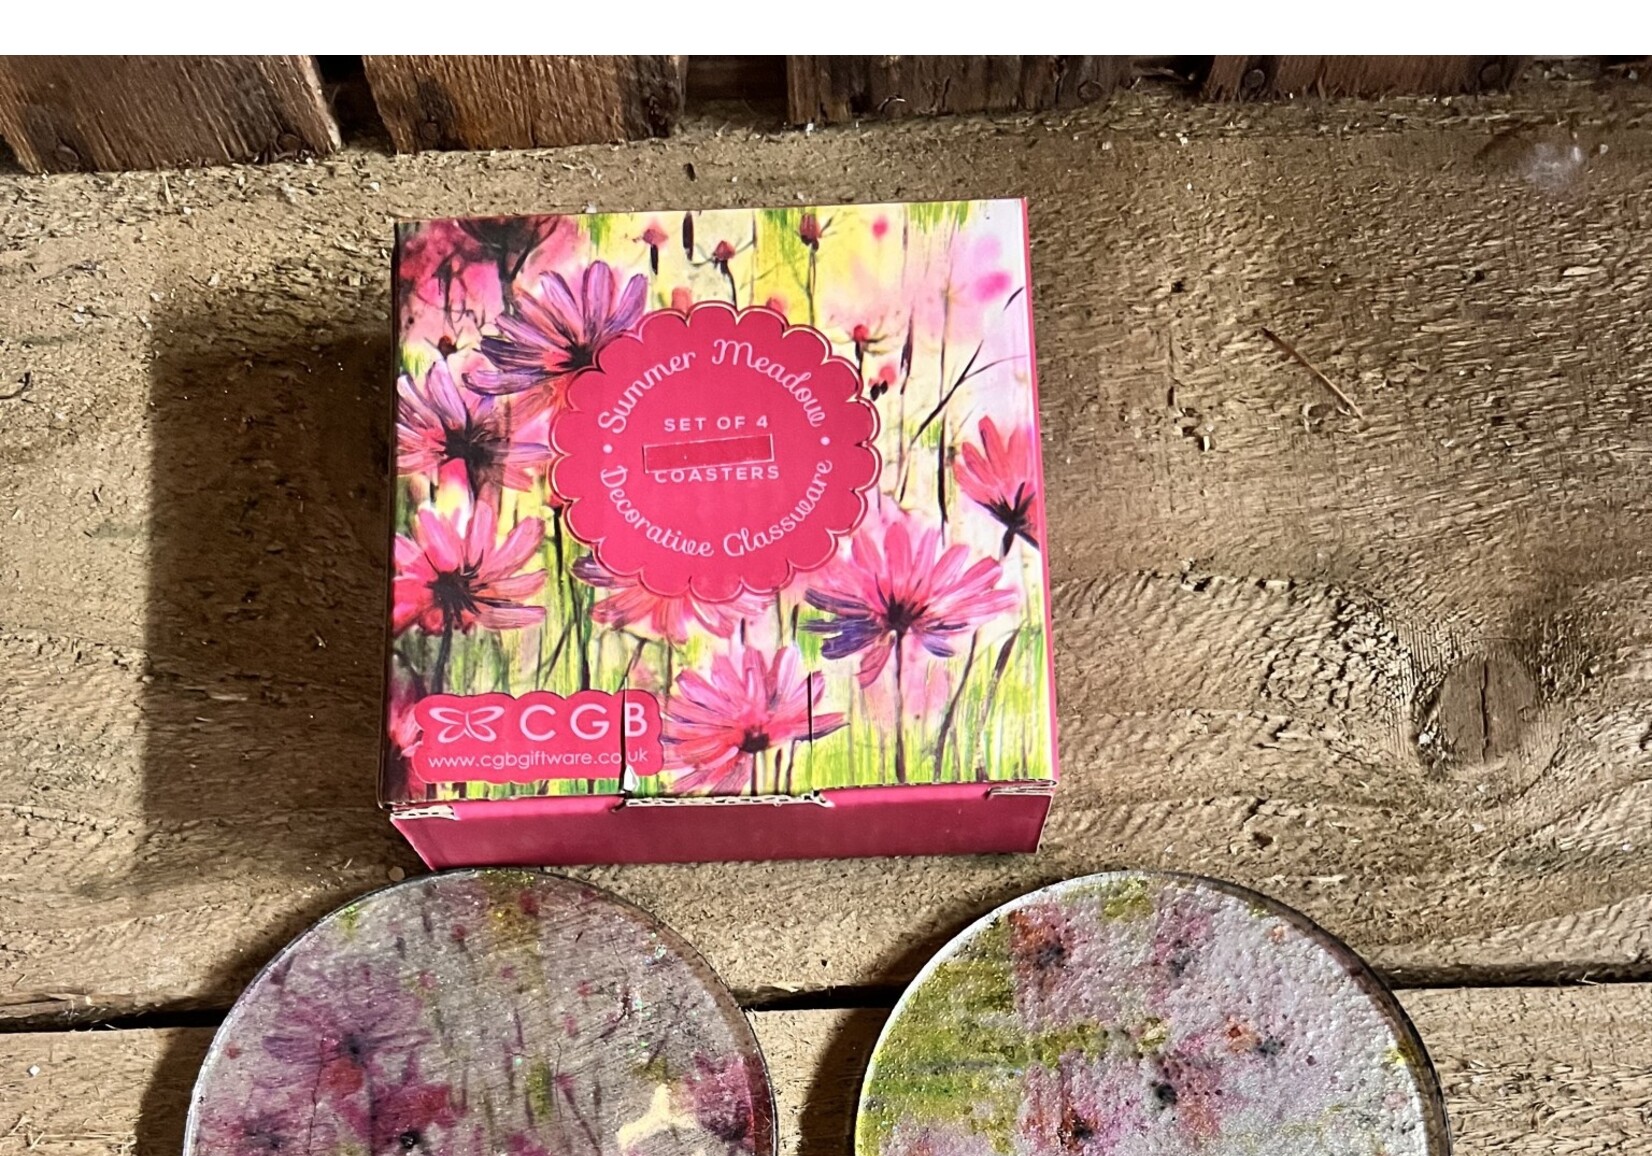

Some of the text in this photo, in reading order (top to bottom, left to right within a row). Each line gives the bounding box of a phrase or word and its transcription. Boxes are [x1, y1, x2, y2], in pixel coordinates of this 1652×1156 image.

[597, 338, 826, 434] Summer Meadow
[663, 415, 769, 432] SET OF 4
[654, 466, 780, 484] COASTERS
[600, 459, 833, 558] Decorative Glassware
[519, 702, 648, 741] CGB
[427, 747, 649, 770] www.cgbgiftware.couk
